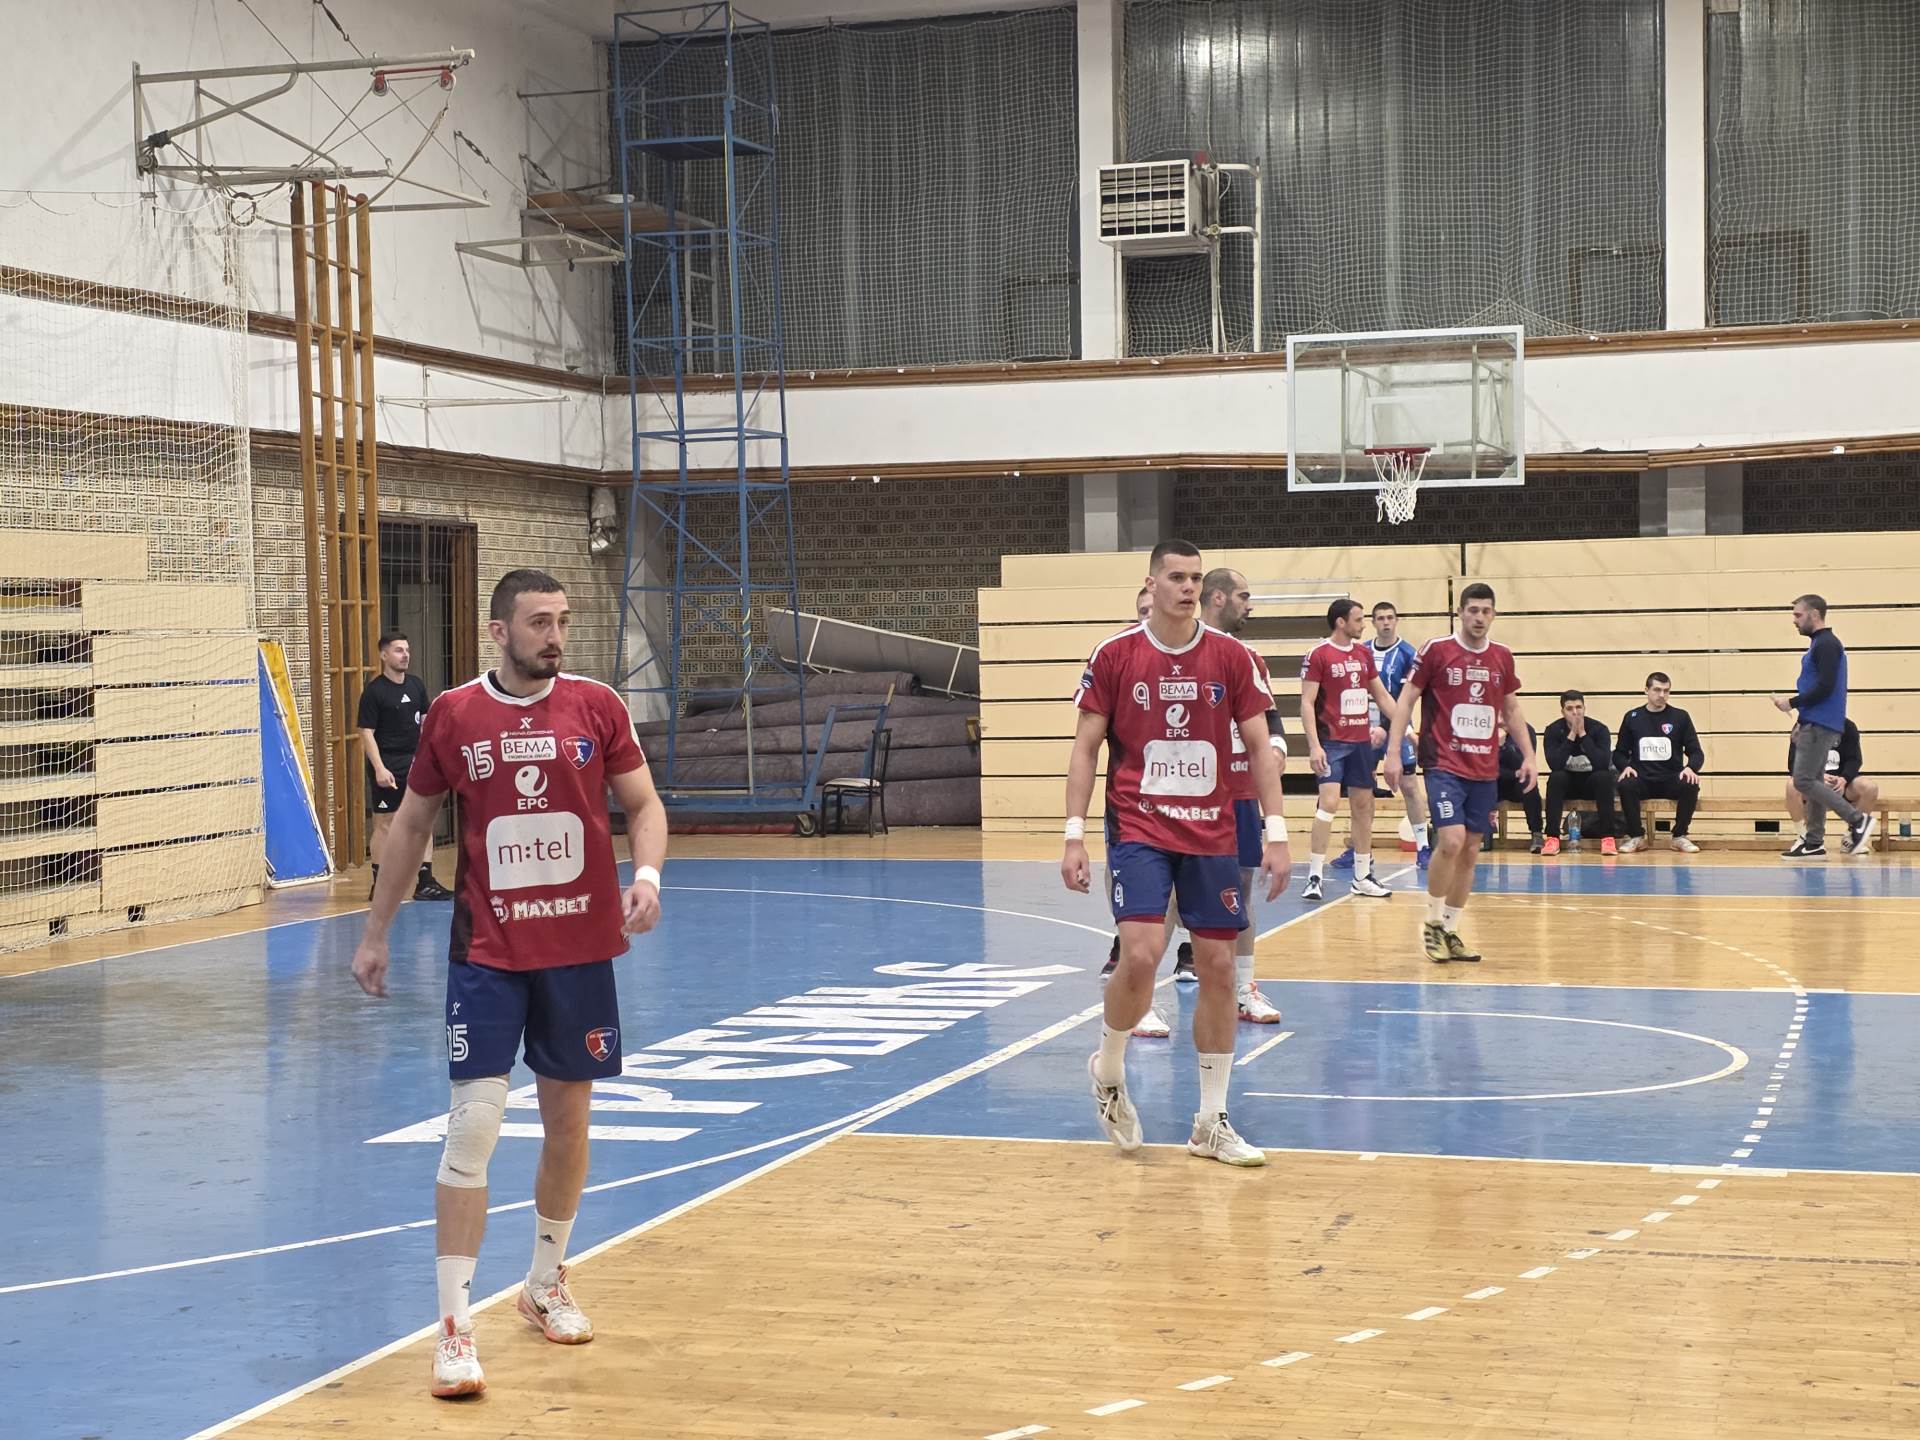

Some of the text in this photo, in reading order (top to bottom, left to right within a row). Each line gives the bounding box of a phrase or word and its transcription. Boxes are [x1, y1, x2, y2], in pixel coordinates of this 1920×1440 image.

[1446, 667, 1463, 686] 13
[1133, 681, 1151, 711] 9
[1160, 684, 1196, 695] BEMA
[1456, 714, 1492, 729] m:tel
[1166, 728, 1190, 738] EPC
[503, 740, 553, 755] BEMA
[460, 740, 495, 782] 15
[1150, 757, 1208, 778] m:tel
[517, 797, 549, 811] EPC
[1156, 804, 1221, 822] MAXBET
[498, 831, 572, 865] m:tel
[1114, 882, 1124, 908] 9
[512, 893, 592, 921] MAXBET
[447, 1024, 469, 1062] 15
